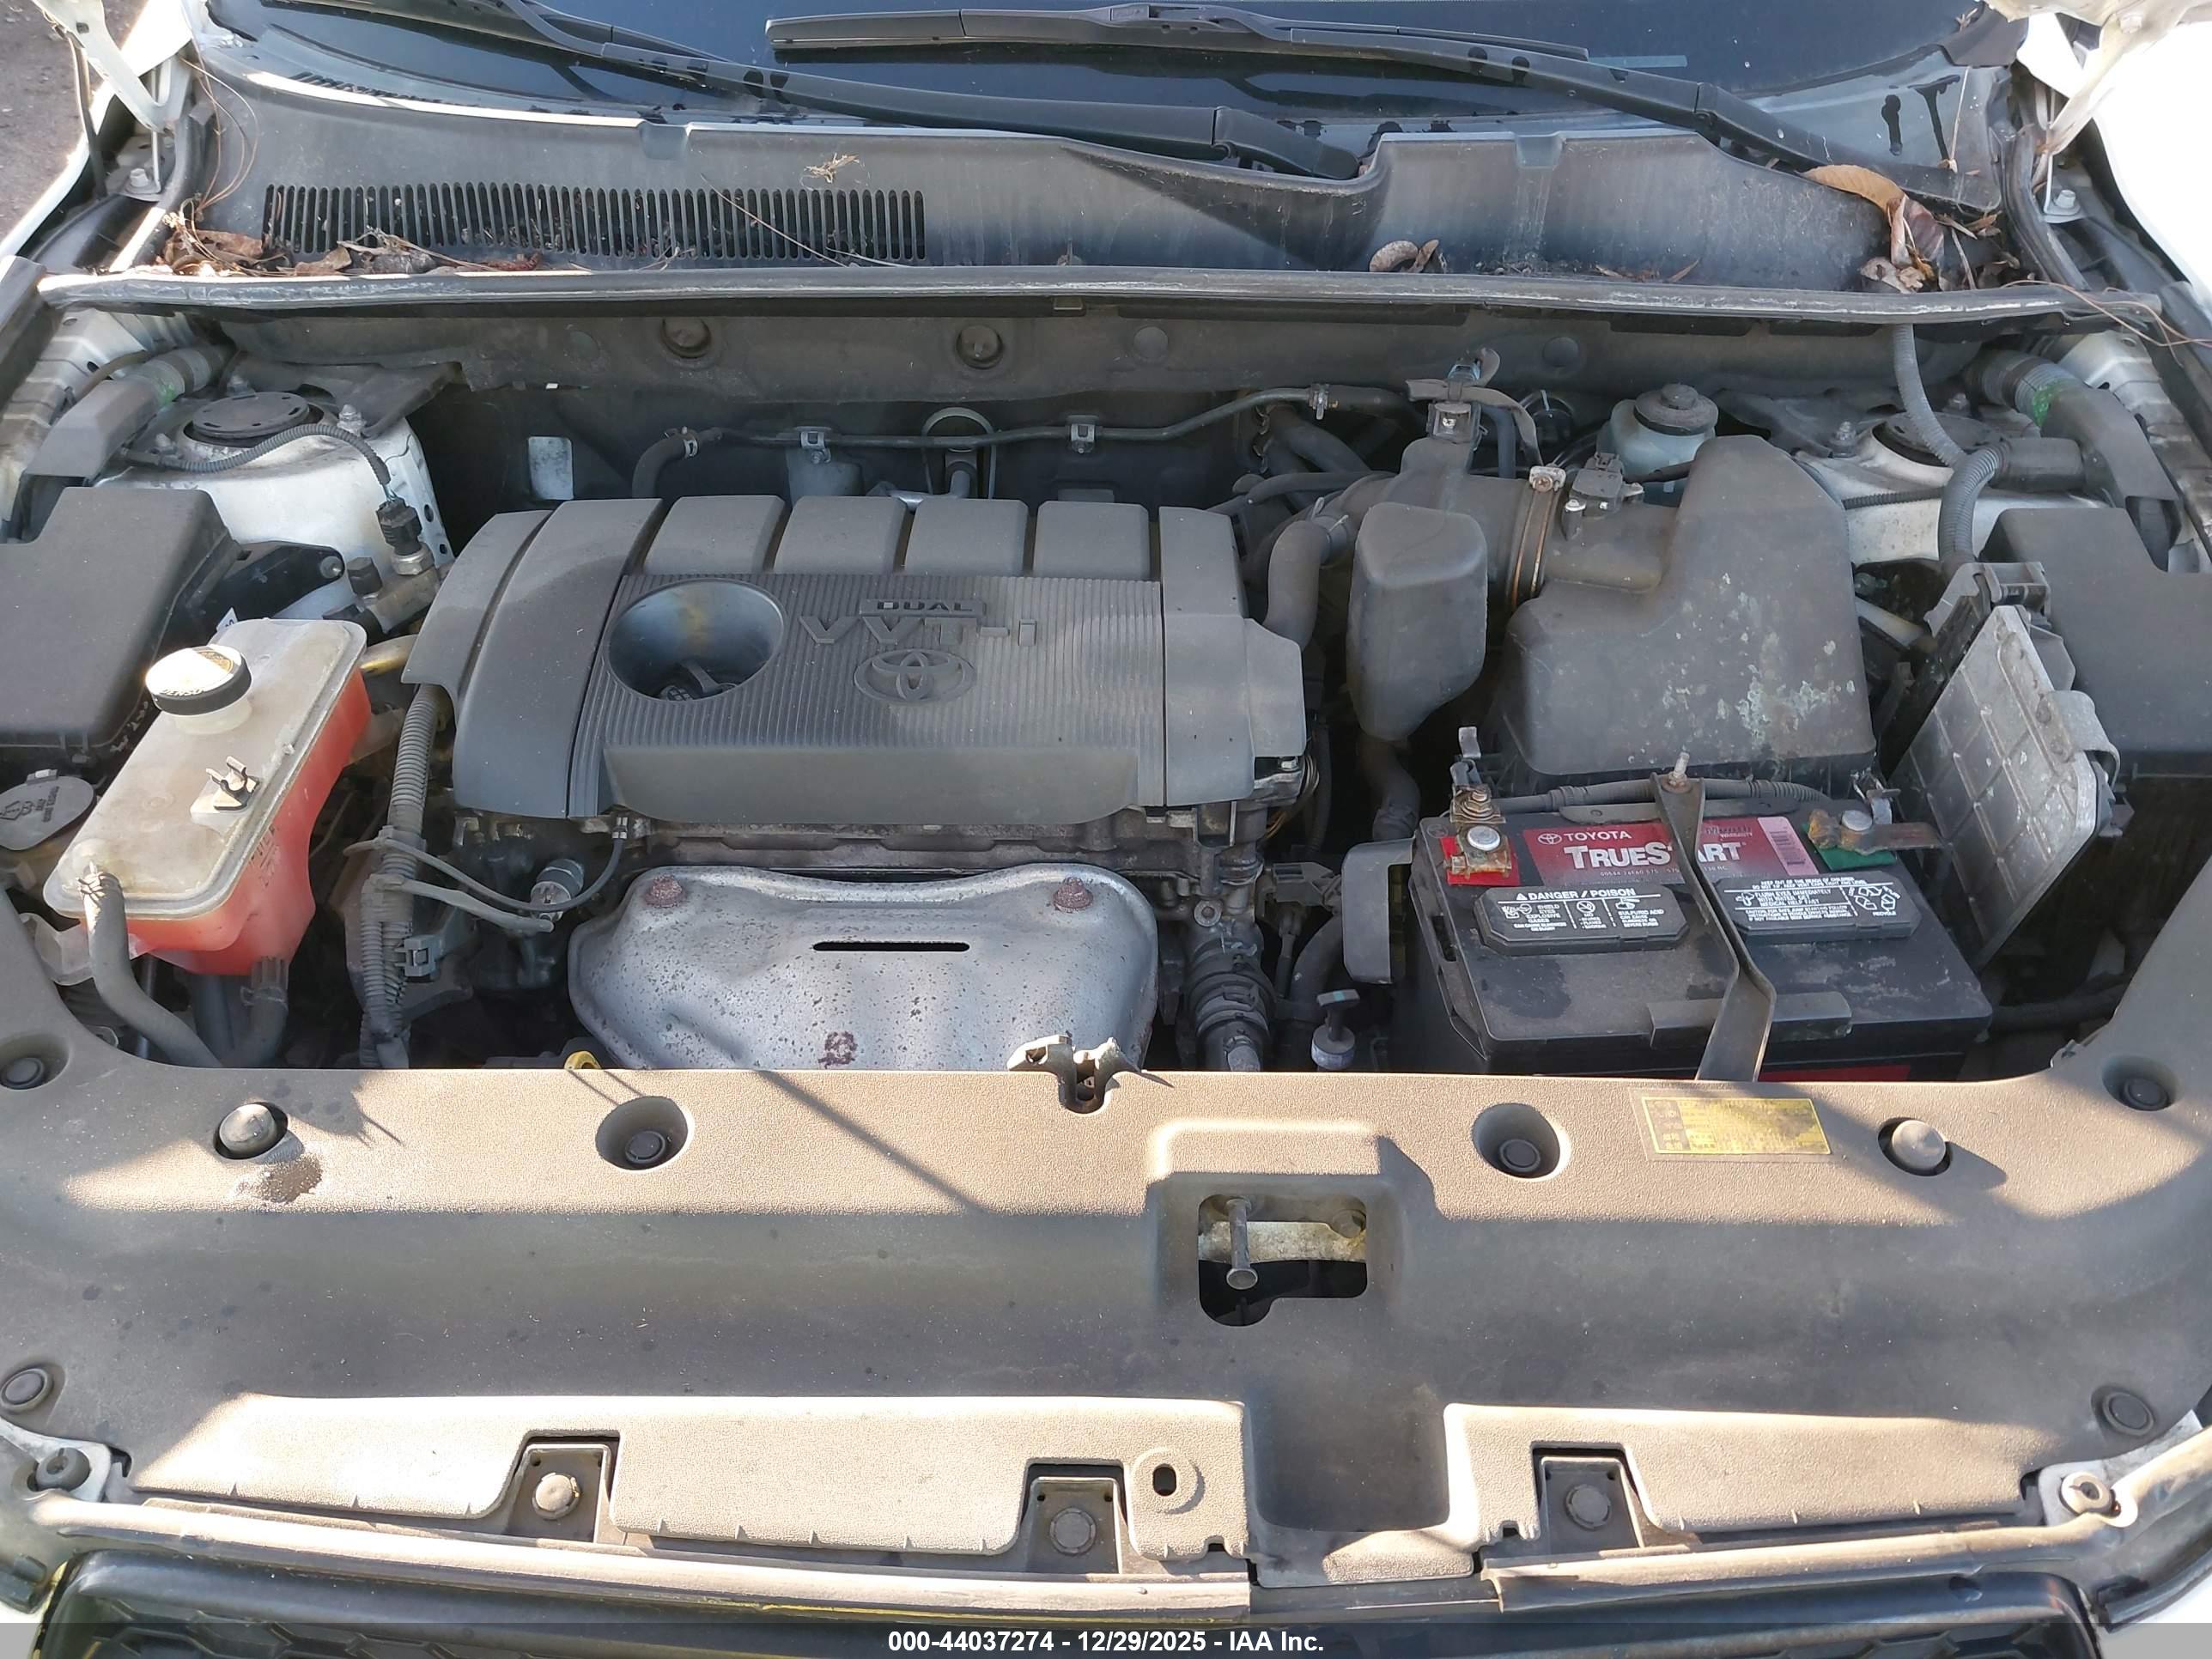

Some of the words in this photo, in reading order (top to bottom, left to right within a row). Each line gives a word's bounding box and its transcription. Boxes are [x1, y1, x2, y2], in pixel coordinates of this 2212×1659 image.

[877, 601, 973, 611] DUAL
[1564, 830, 1632, 842] TOYOTA
[1528, 890, 1579, 901] DANGER
[1589, 888, 1637, 897] POISON
